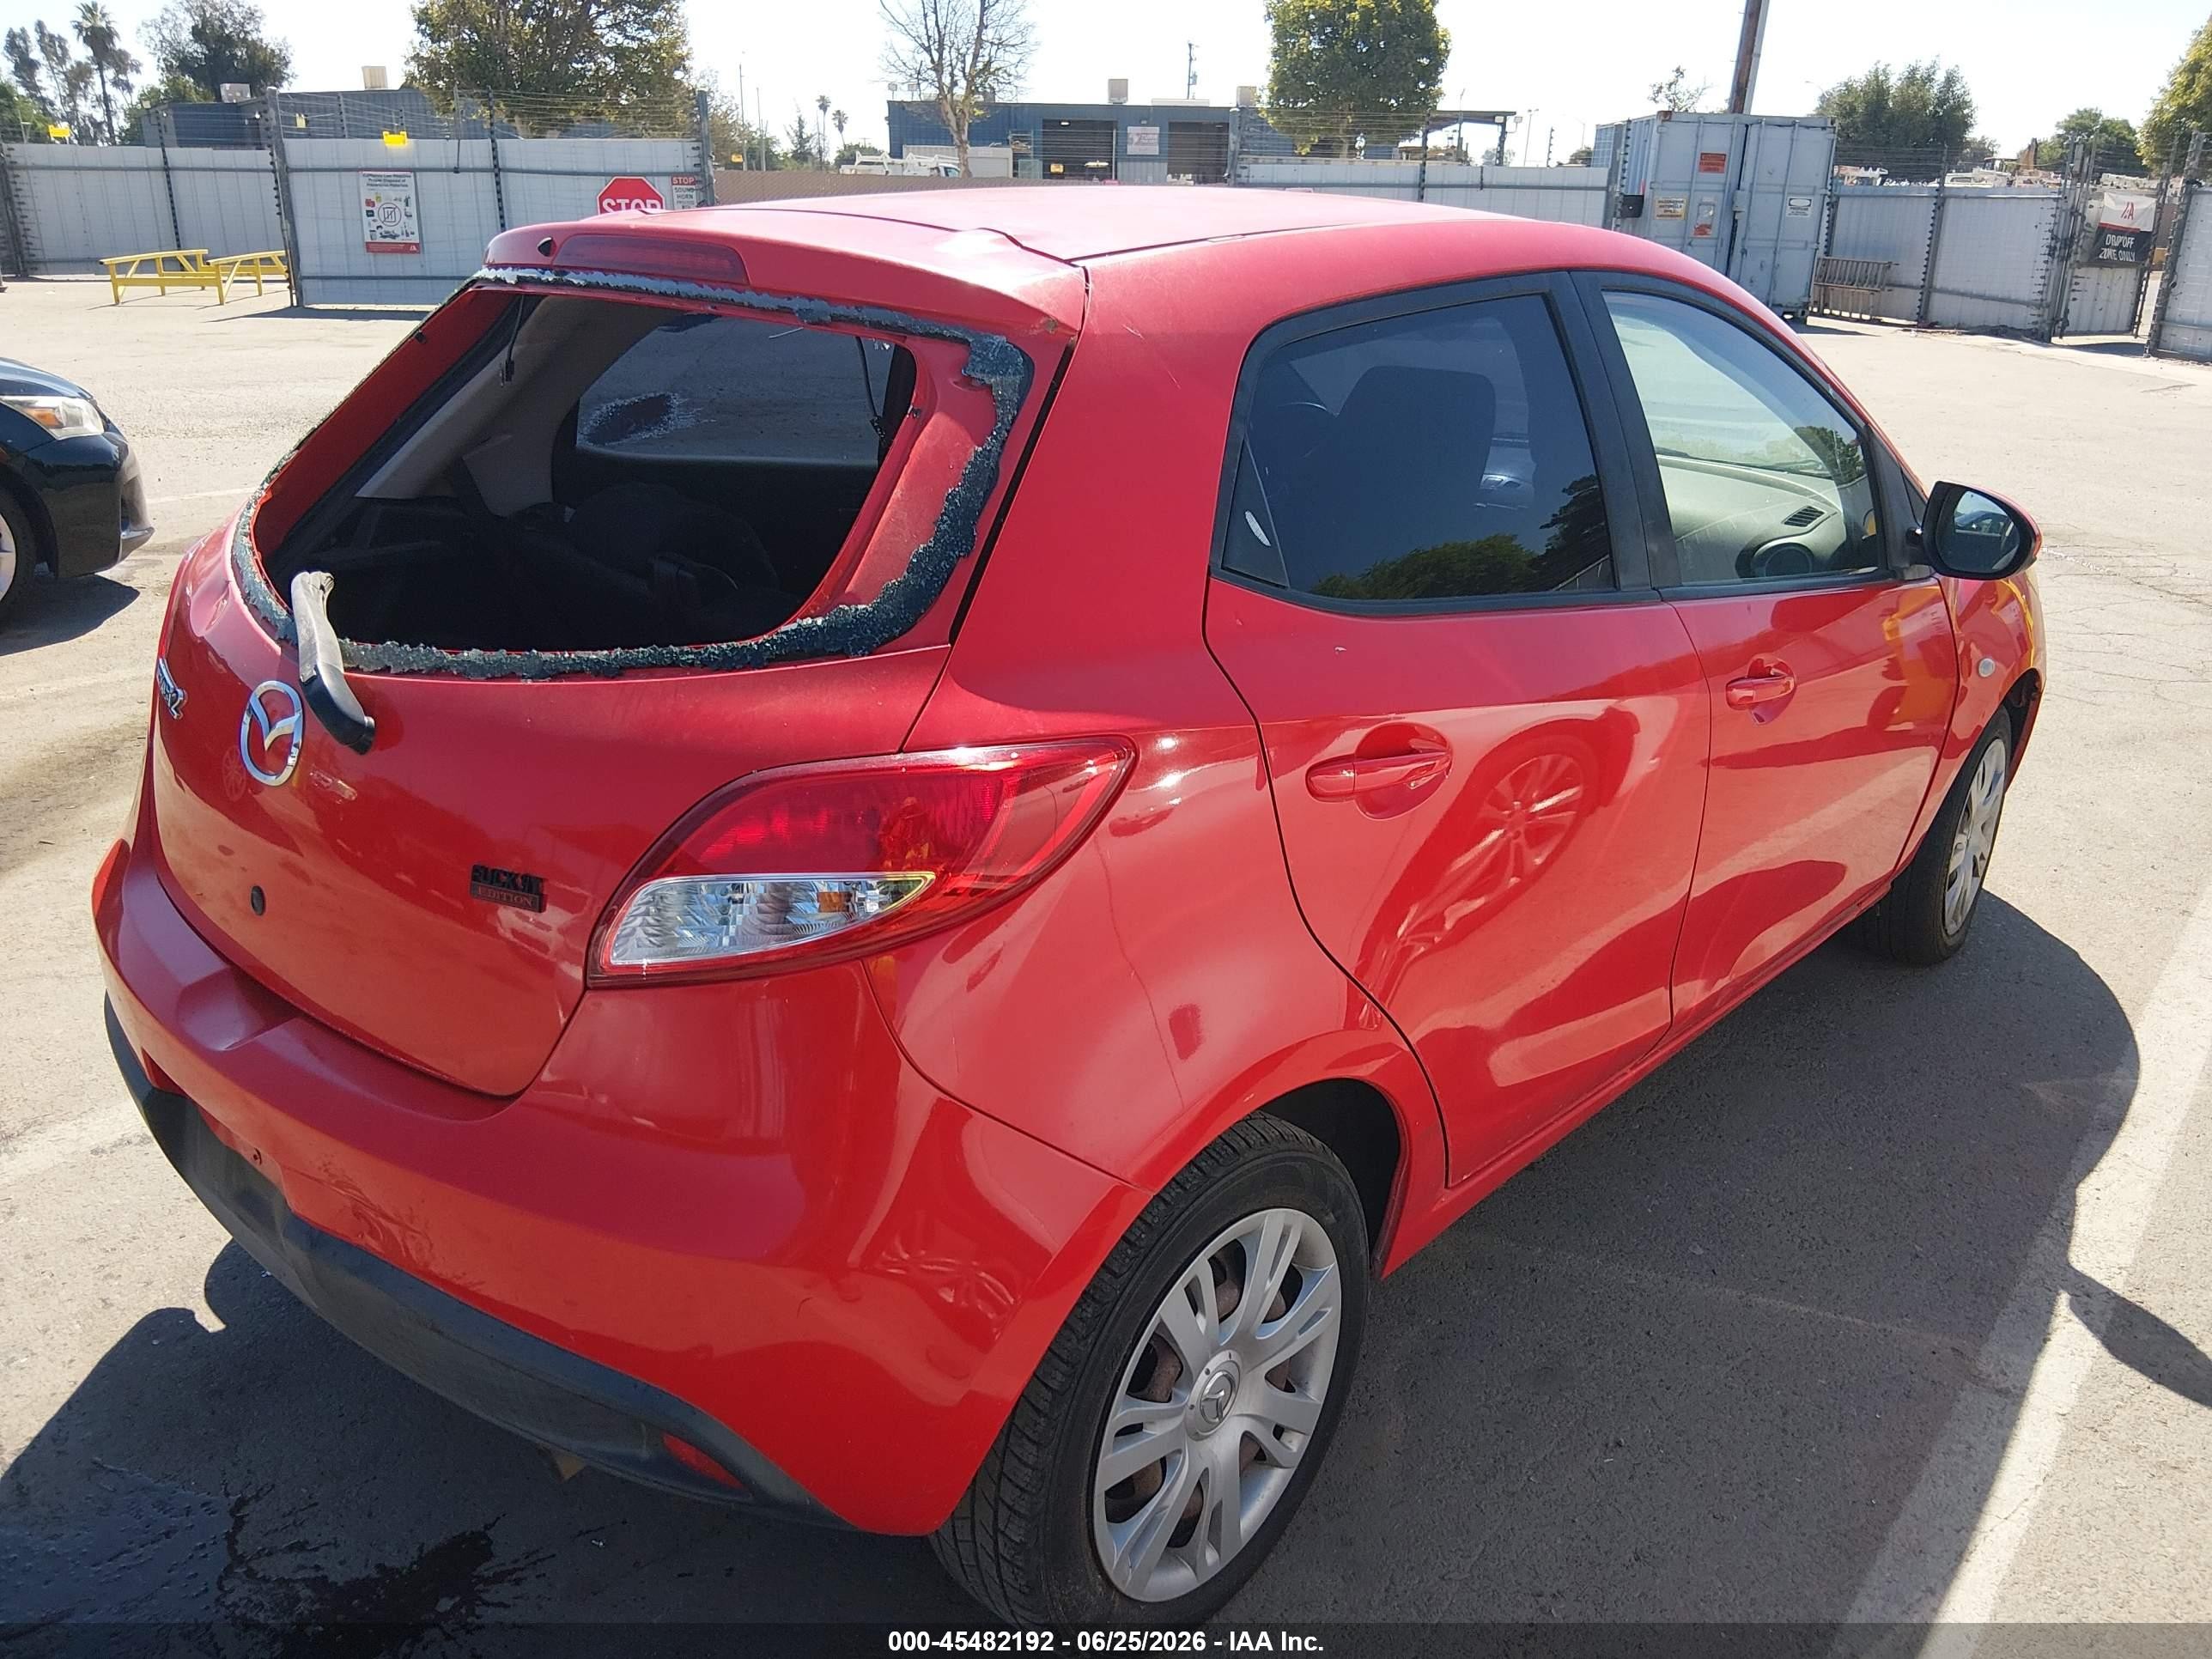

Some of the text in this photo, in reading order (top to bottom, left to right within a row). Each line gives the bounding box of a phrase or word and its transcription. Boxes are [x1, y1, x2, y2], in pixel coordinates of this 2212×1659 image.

[2122, 236, 2136, 249] OFF
[2118, 249, 2136, 262] ONLY
[477, 886, 532, 908] EDITION
